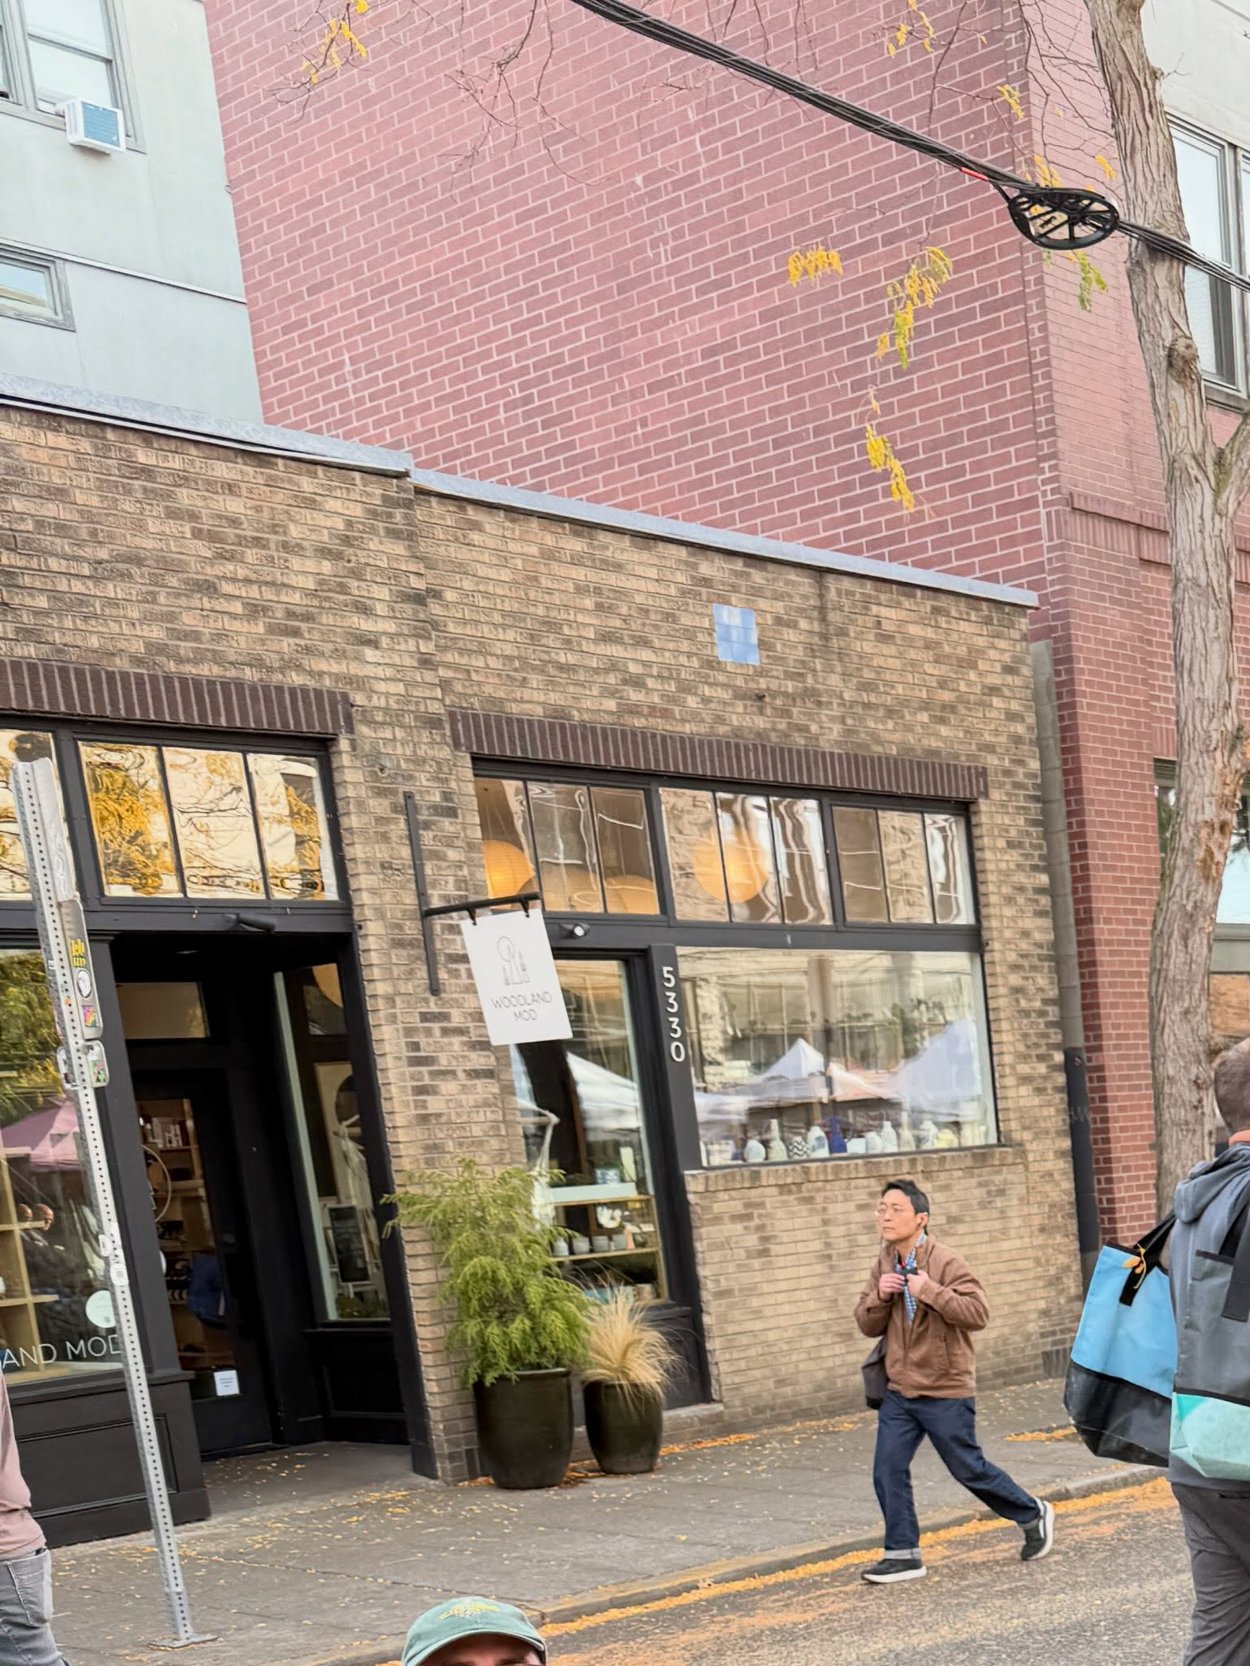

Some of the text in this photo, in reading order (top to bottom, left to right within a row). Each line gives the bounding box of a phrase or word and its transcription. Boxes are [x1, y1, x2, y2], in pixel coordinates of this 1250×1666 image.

[491, 991, 553, 1009] WOODLAND
[513, 1008, 538, 1022] MOD
[662, 966, 686, 1062] 5330
